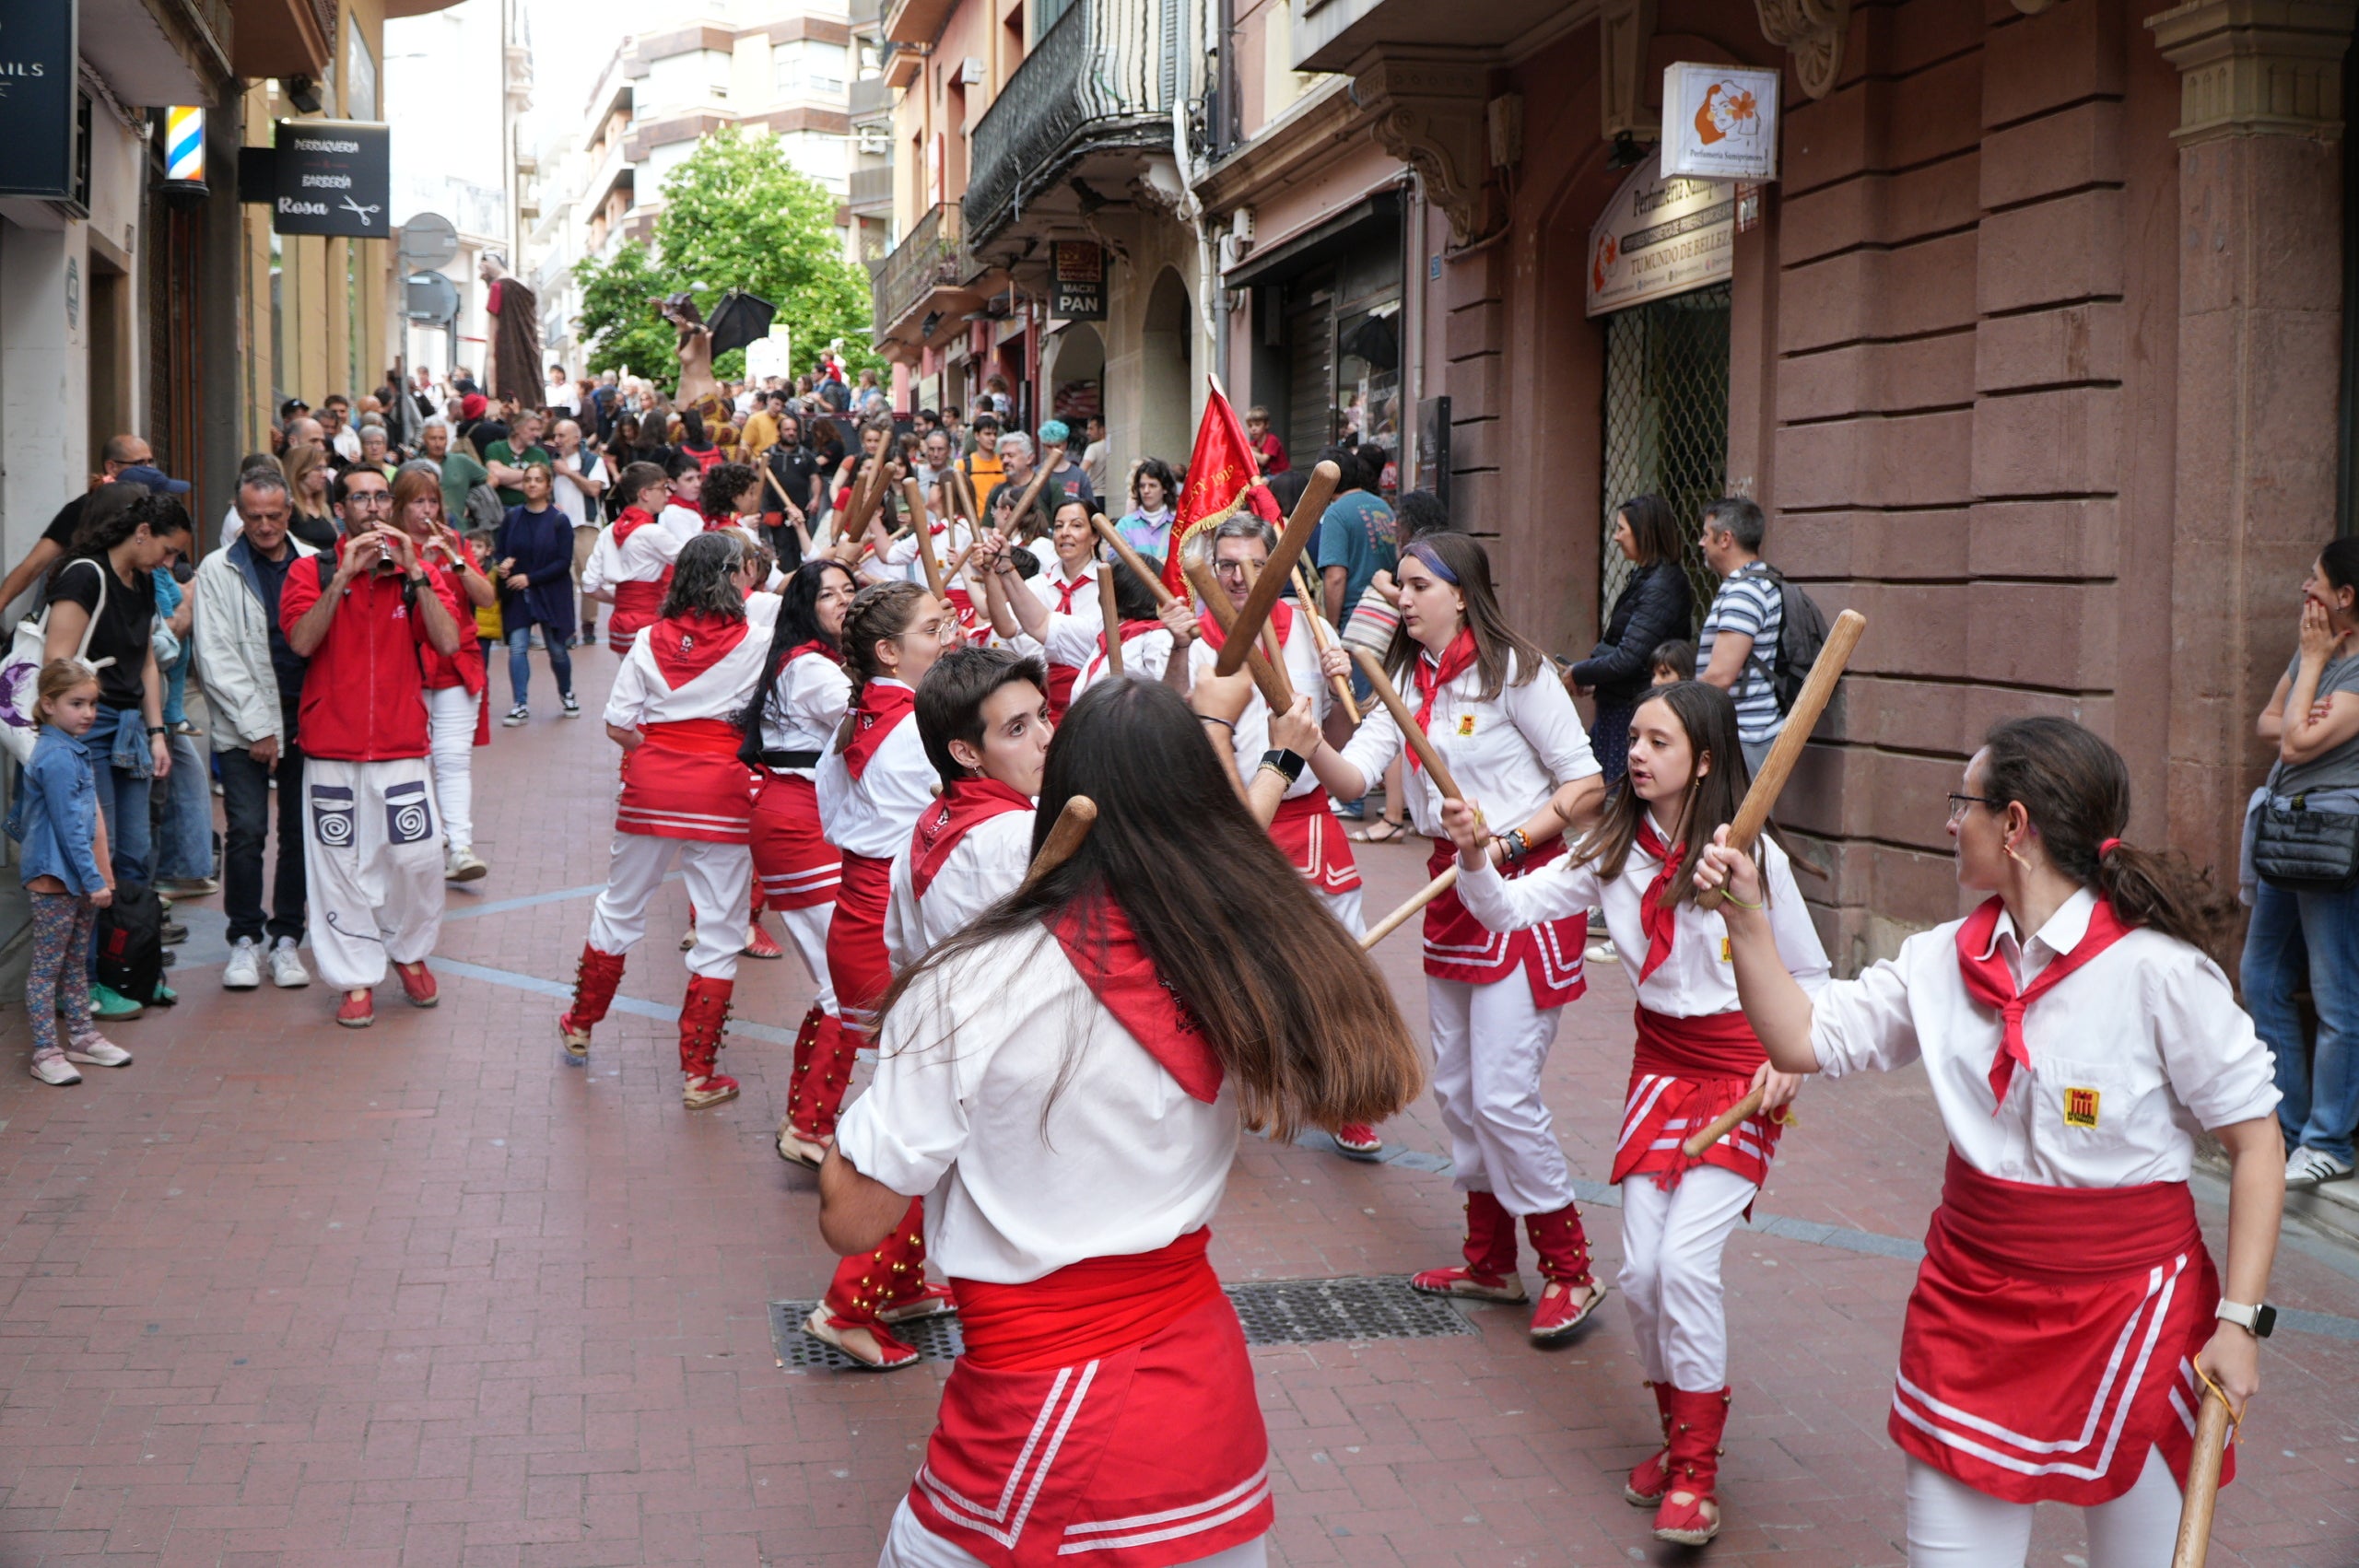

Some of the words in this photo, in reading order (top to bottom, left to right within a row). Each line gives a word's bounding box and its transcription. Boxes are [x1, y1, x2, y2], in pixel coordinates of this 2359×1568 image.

[278, 196, 329, 216] Rosa
[1644, 246, 1677, 272] MUNDO
[1680, 241, 1693, 261] DE
[1059, 296, 1097, 311] PAN
